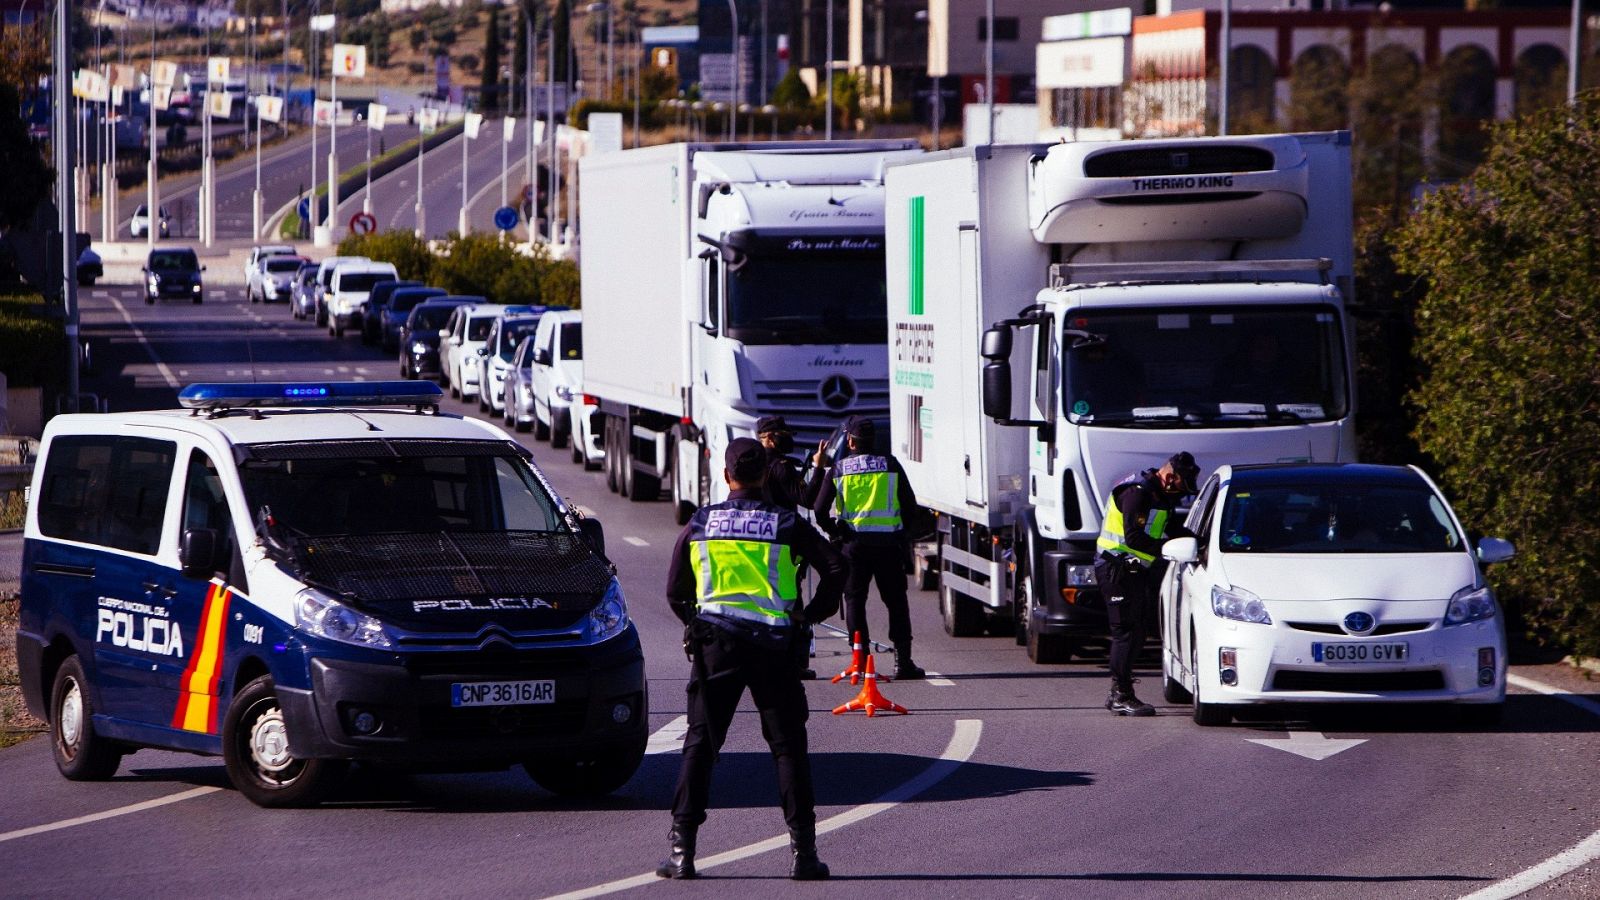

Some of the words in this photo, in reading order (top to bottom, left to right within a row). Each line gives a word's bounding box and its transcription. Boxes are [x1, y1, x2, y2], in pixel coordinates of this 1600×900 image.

[1133, 177, 1196, 190] THERMO
[1198, 176, 1234, 188] KING
[1325, 645, 1367, 660] 6030
[1373, 644, 1405, 660] GVW
